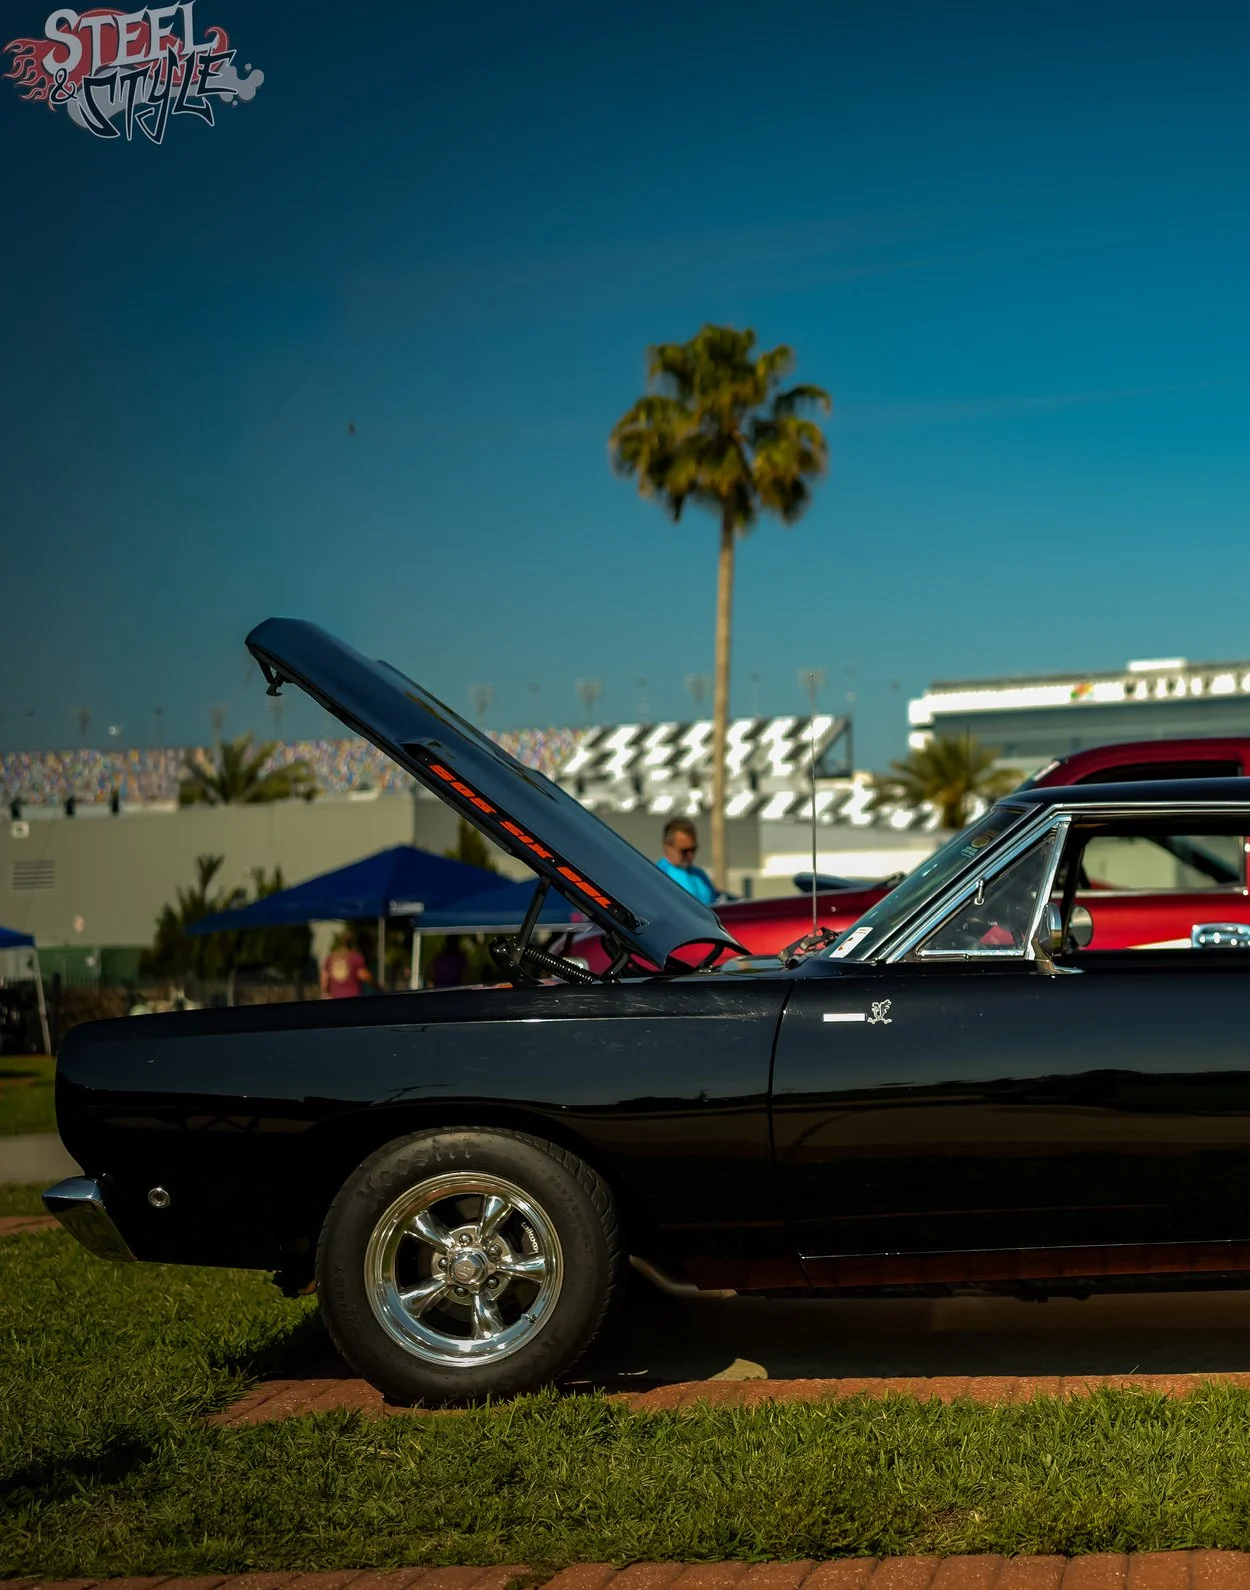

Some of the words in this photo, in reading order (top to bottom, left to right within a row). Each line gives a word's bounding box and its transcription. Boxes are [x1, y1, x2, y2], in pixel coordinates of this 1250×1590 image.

[429, 764, 497, 814] 505
[500, 820, 554, 860] SIX
[556, 866, 612, 910] BBL
